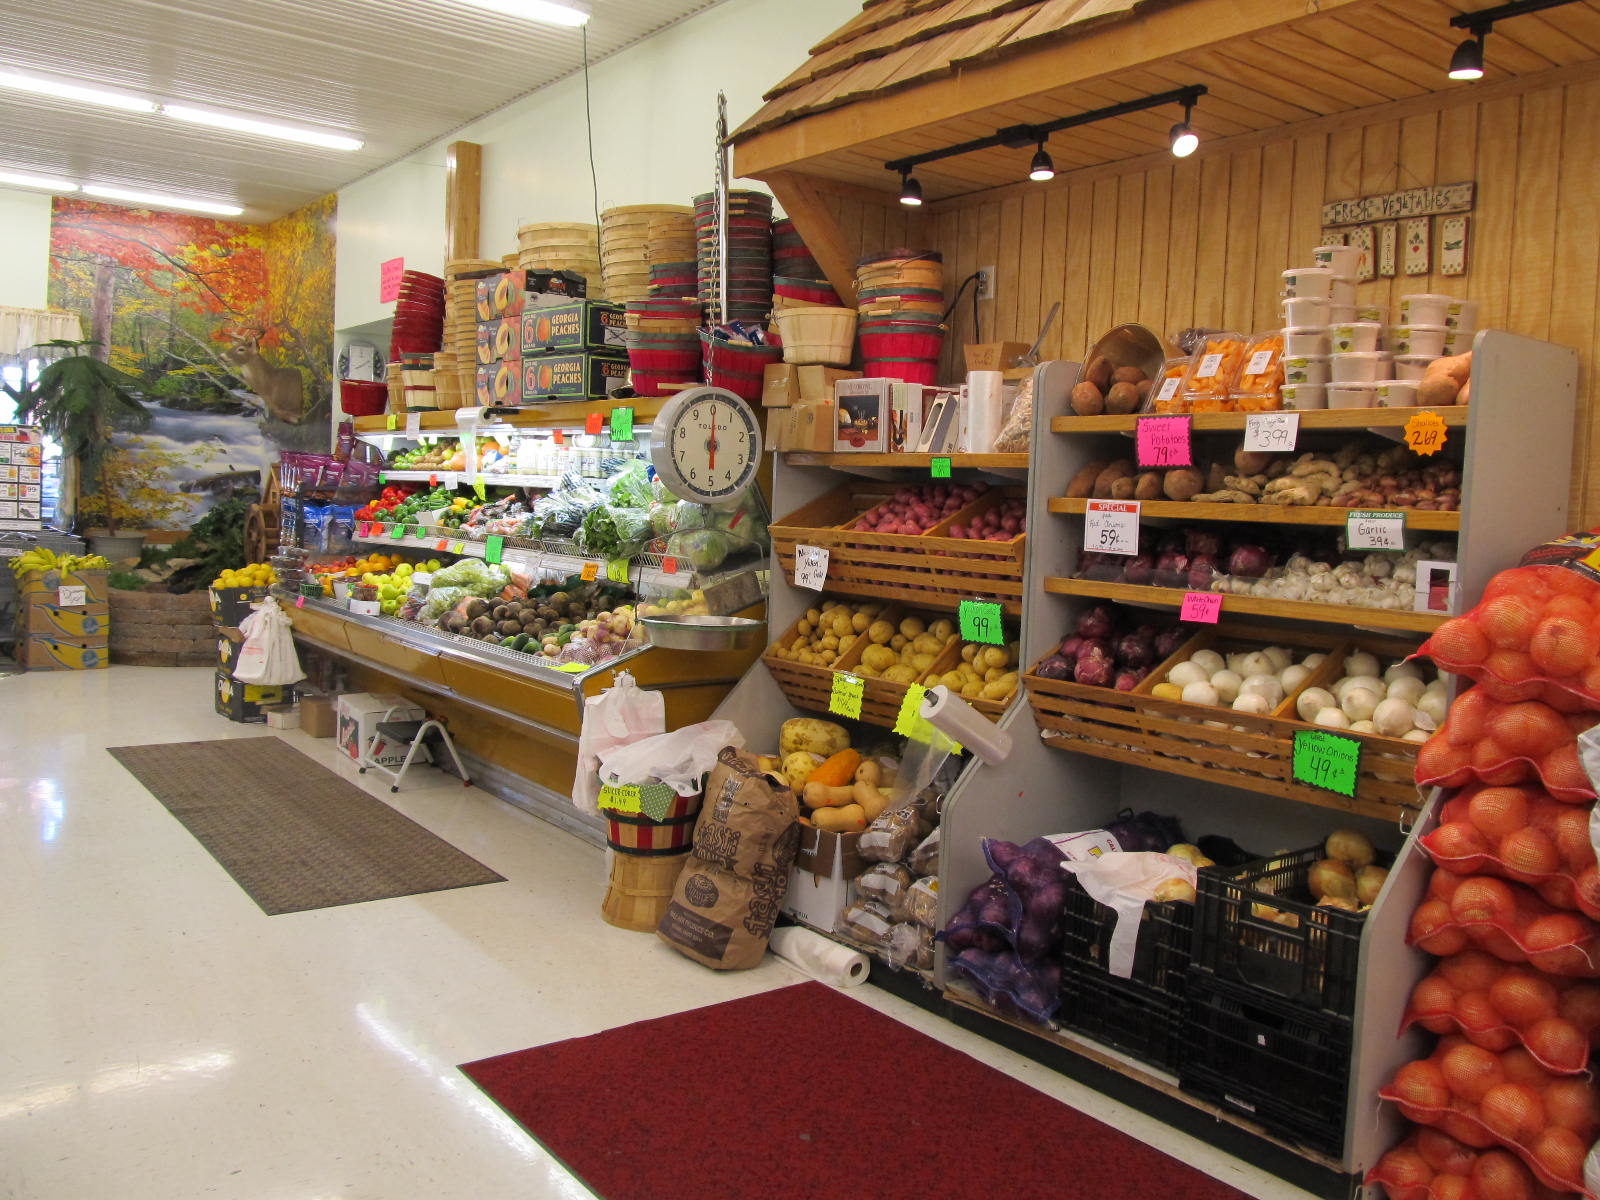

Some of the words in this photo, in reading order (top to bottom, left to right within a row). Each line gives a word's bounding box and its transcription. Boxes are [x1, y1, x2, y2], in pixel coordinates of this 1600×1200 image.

[551, 313, 579, 325] GEORGIA
[609, 313, 626, 321] GEORG
[551, 324, 580, 336] PEACHES
[553, 362, 581, 373] GEORGIA
[553, 372, 582, 385] PEACHES
[693, 409, 700, 421] 9
[710, 404, 717, 416] 0
[679, 427, 686, 439] 8
[738, 431, 745, 443] 2
[679, 451, 686, 462] 7
[737, 454, 744, 465] 3
[689, 468, 697, 480] 6
[724, 469, 732, 481] 4
[708, 475, 714, 487] 5
[1098, 503, 1127, 512] SPECIAL
[1358, 522, 1387, 536] Garlic
[1296, 737, 1326, 755] Yellow
[1326, 746, 1354, 761] Onions
[375, 755, 409, 765] APPLE
